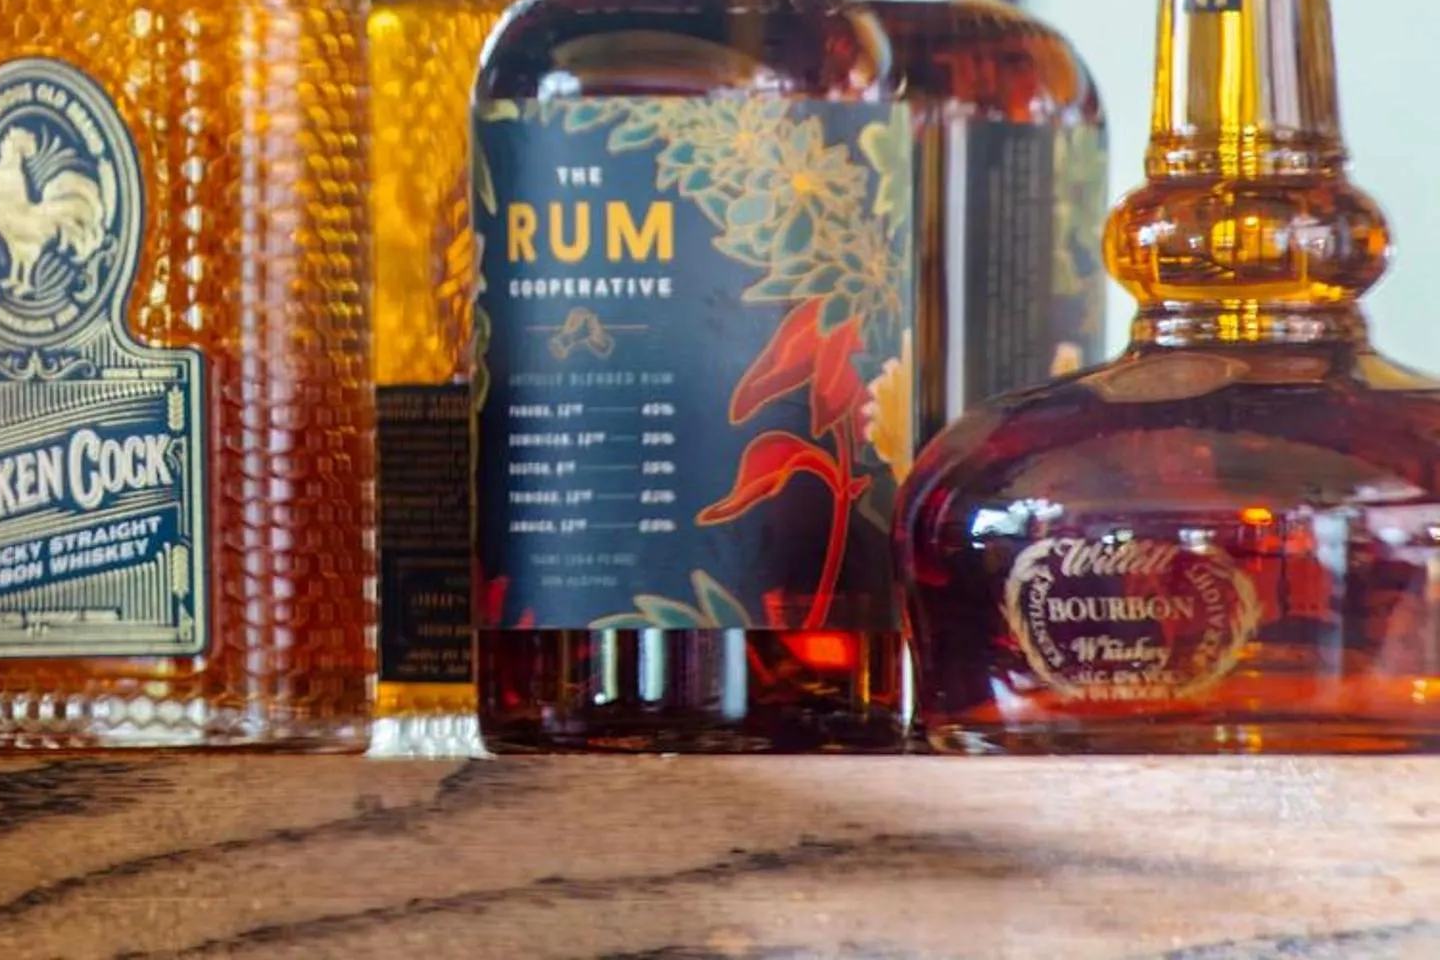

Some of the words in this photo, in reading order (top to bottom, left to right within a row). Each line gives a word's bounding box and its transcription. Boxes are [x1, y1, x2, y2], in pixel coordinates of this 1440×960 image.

[557, 167, 603, 185] THE
[507, 201, 675, 262] RUM
[509, 278, 673, 298] COOPERATIVE
[68, 428, 174, 509] COCK
[49, 515, 162, 554] STRAIGHT
[49, 539, 149, 576] WHISKEY
[1047, 596, 1195, 621] BOURBON
